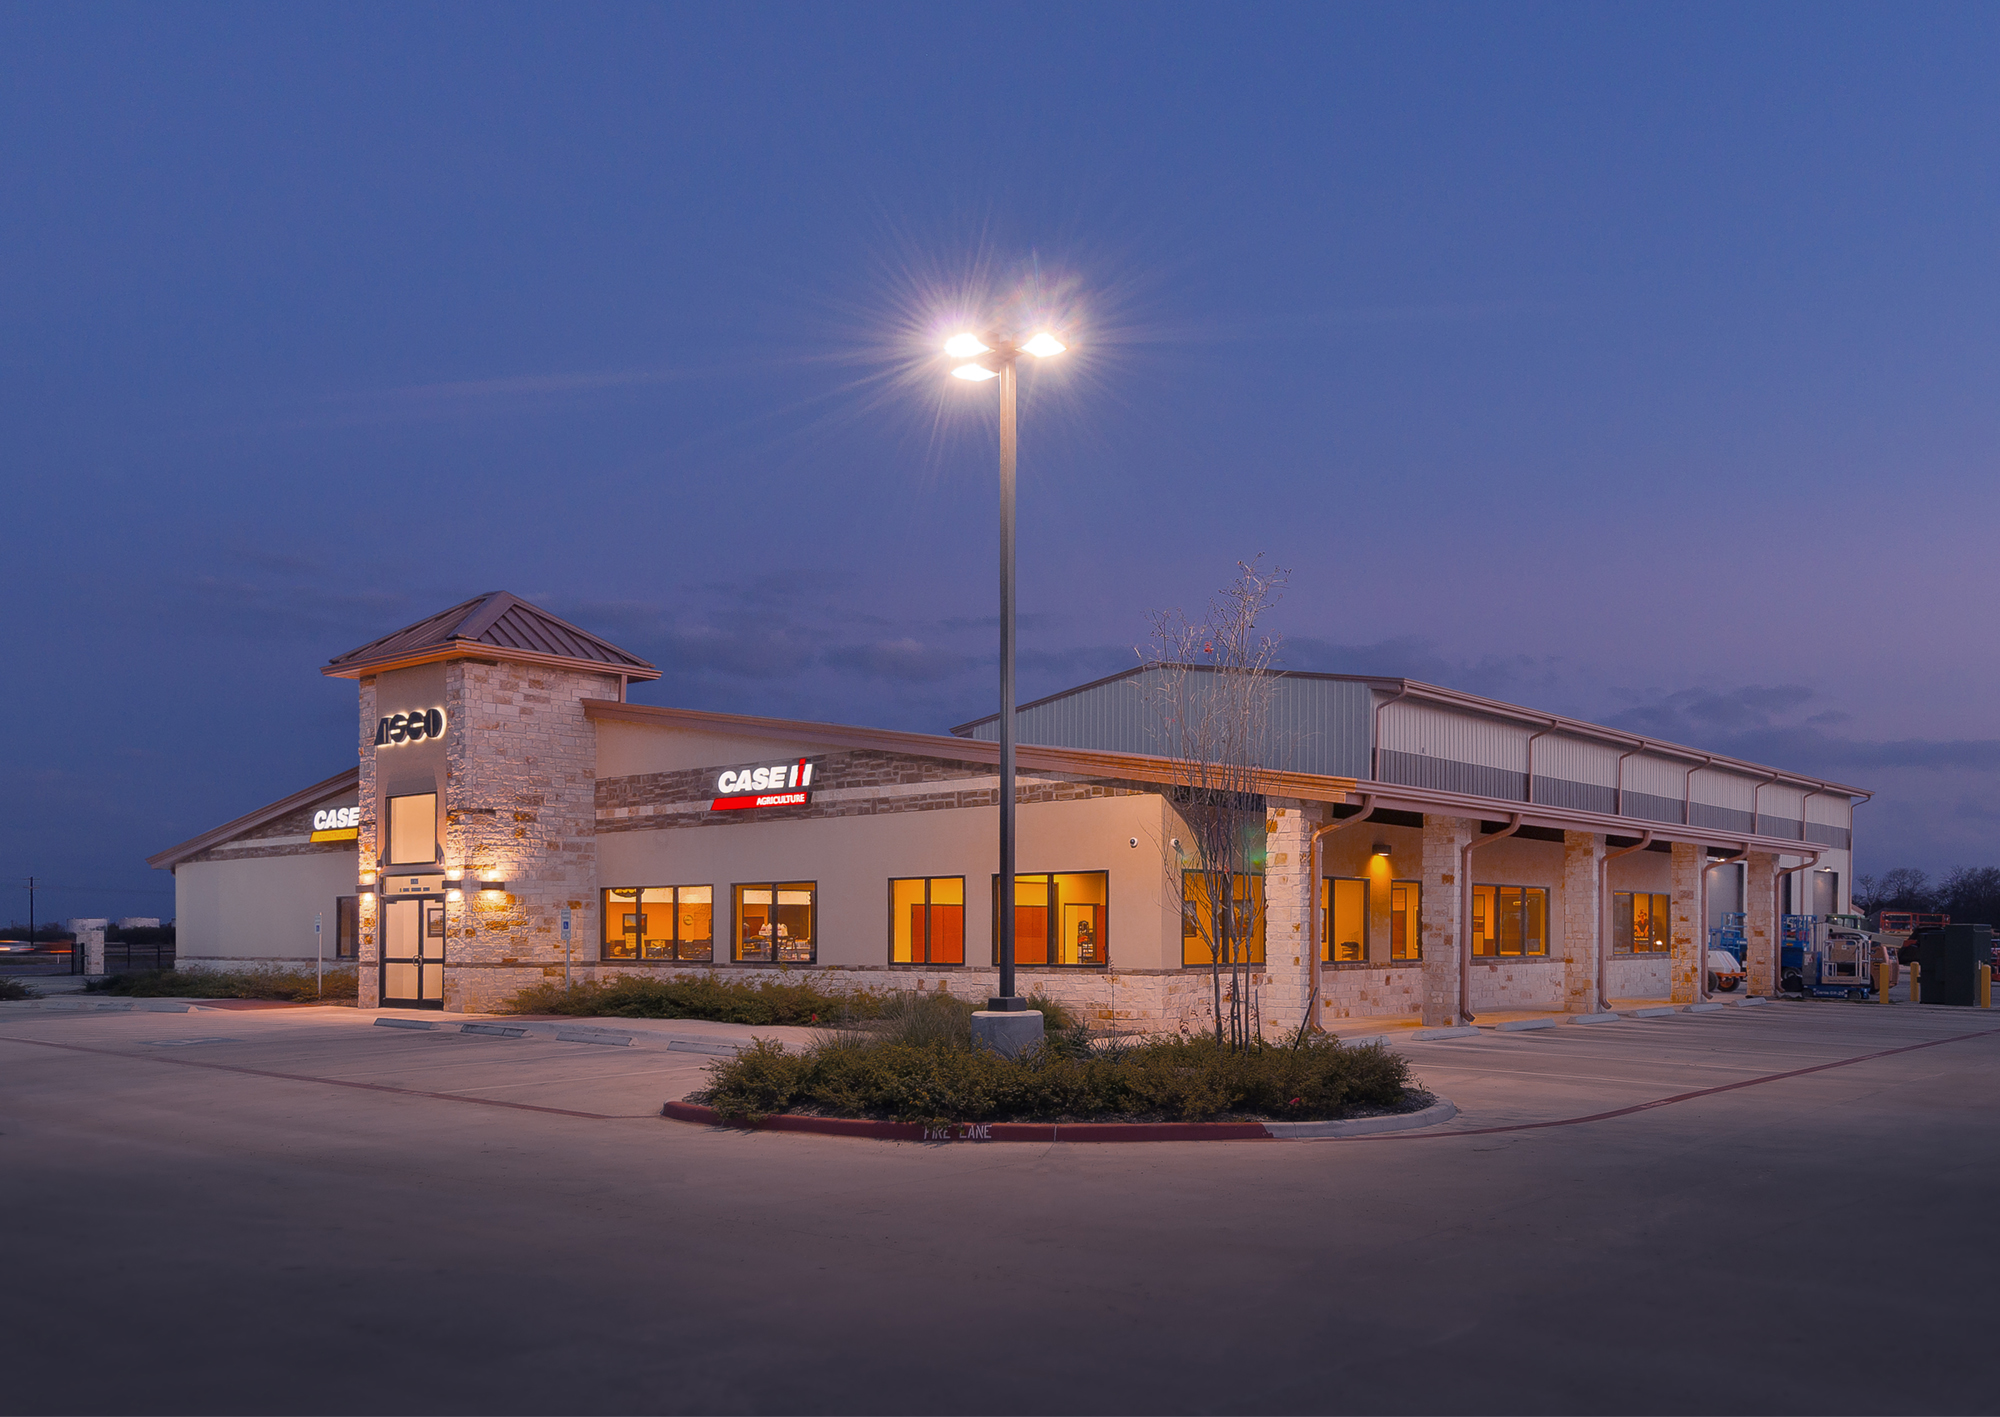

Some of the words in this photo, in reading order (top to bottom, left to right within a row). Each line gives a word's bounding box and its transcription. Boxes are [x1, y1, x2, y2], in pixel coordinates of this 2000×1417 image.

[374, 708, 444, 746] ASCO
[718, 766, 788, 794] CASE
[756, 793, 805, 806] AGRICULTURE
[313, 806, 360, 831] CASE
[318, 830, 357, 840] CONSTRUCTION
[959, 1124, 992, 1139] LANE
